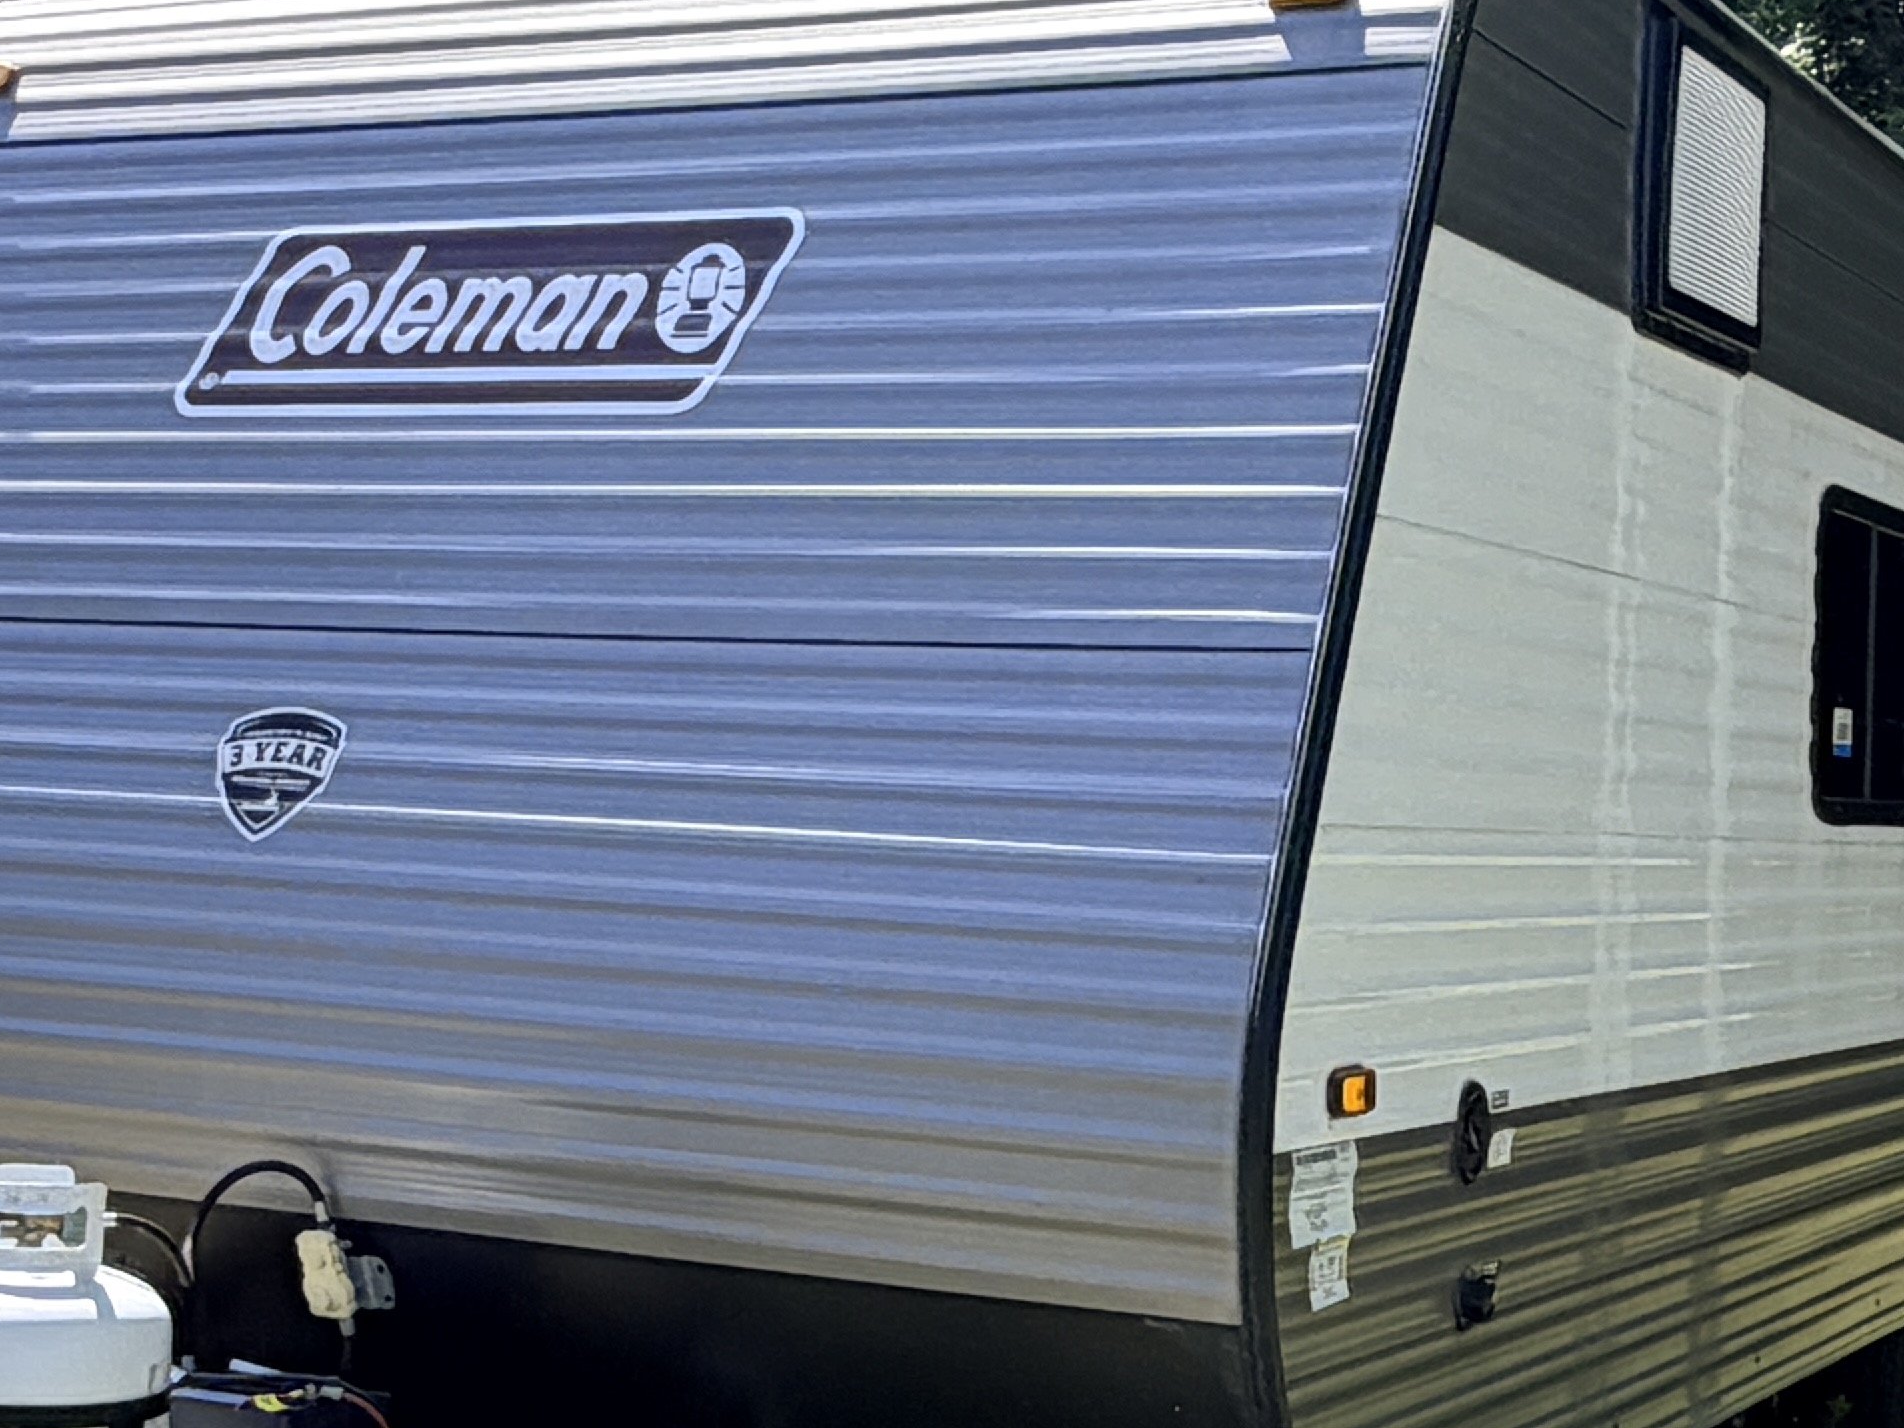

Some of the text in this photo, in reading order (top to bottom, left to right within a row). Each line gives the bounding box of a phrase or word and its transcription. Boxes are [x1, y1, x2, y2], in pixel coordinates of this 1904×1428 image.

[249, 245, 649, 364] Coleman
[229, 741, 329, 772] 3 YEAR
